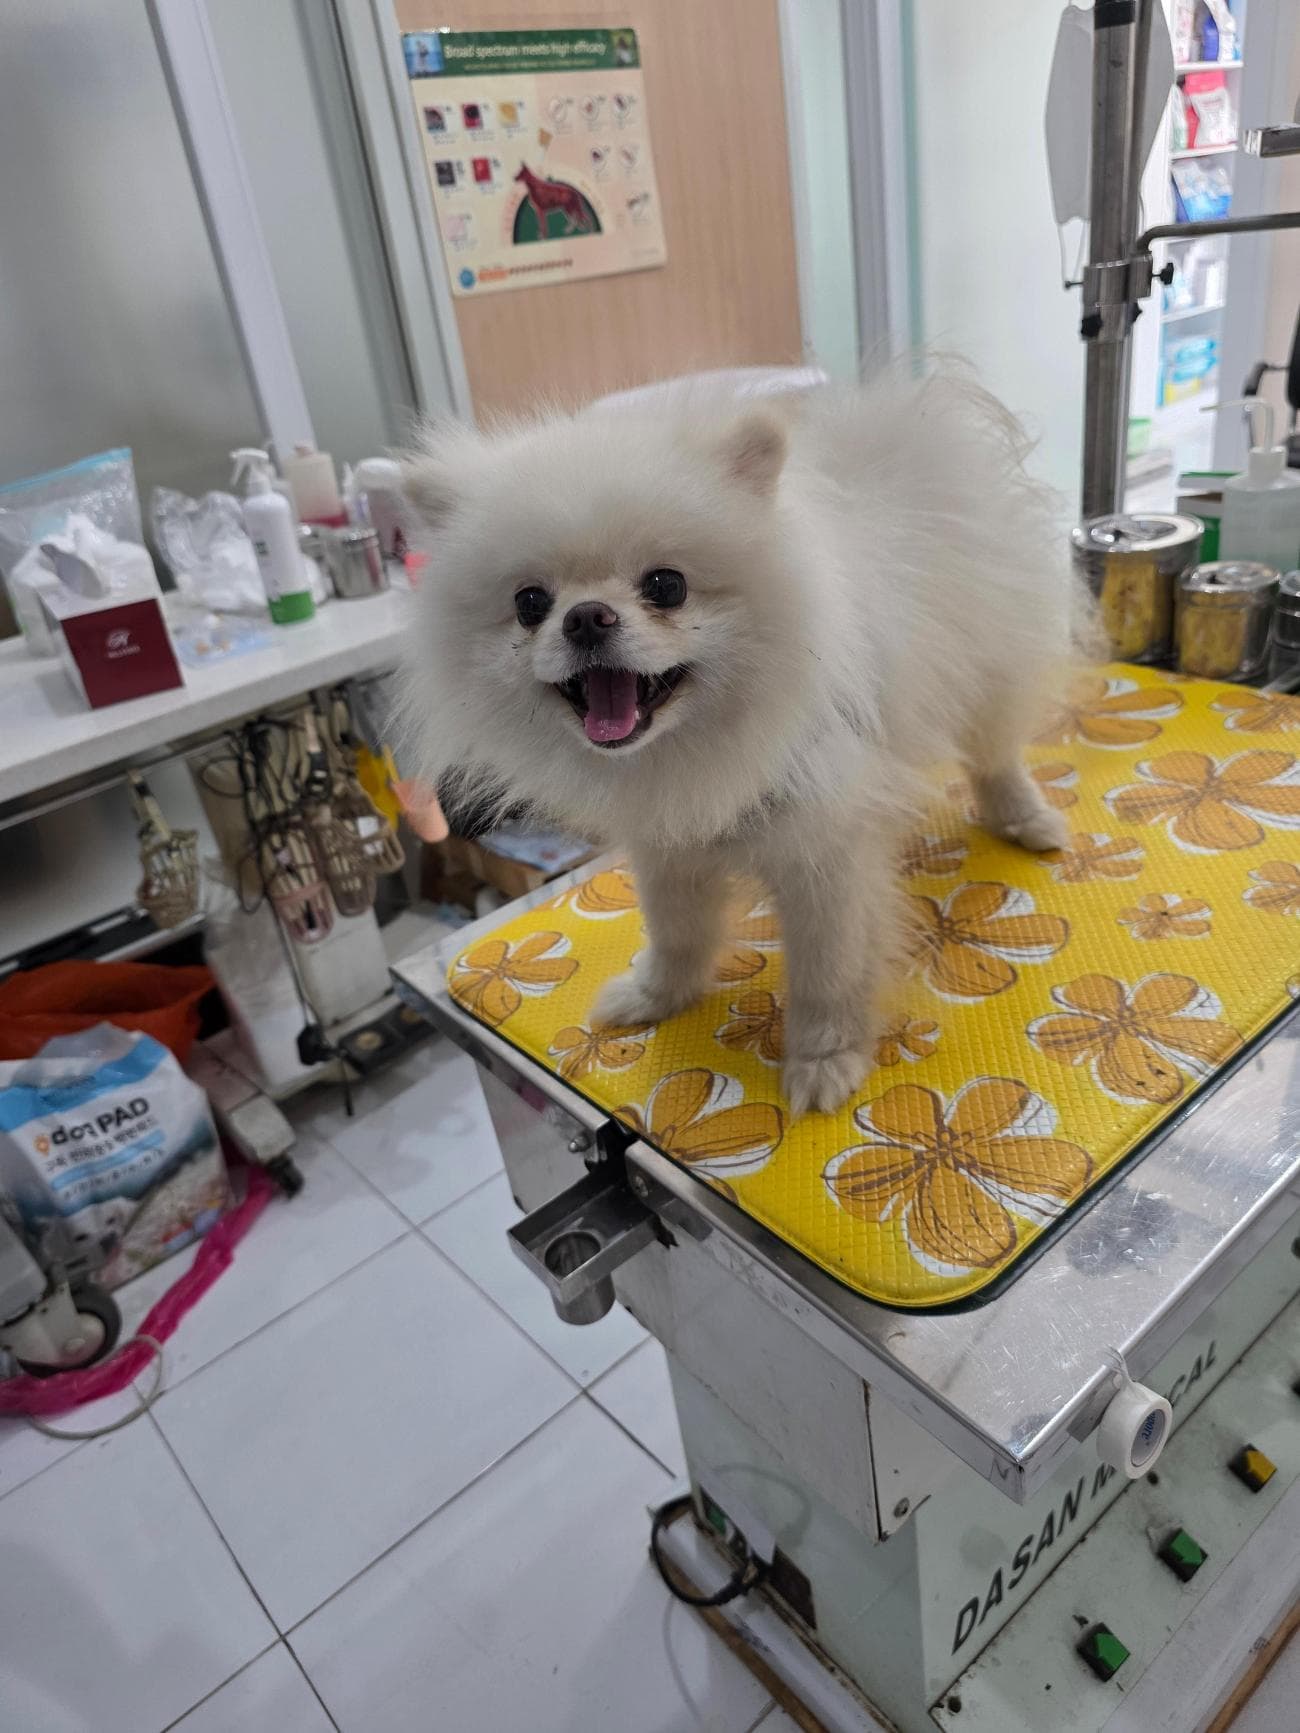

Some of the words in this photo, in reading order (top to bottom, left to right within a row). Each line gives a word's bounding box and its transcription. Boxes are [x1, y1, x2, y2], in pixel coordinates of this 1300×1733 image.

[444, 46, 475, 59] Broad
[476, 44, 519, 60] spectrum
[521, 43, 550, 56] meets
[550, 41, 570, 57] high
[573, 41, 607, 56] efficacy
[96, 1097, 150, 1134] PAD
[951, 1475, 1085, 1656] DASAN
[1090, 1340, 1216, 1498] MCAL
